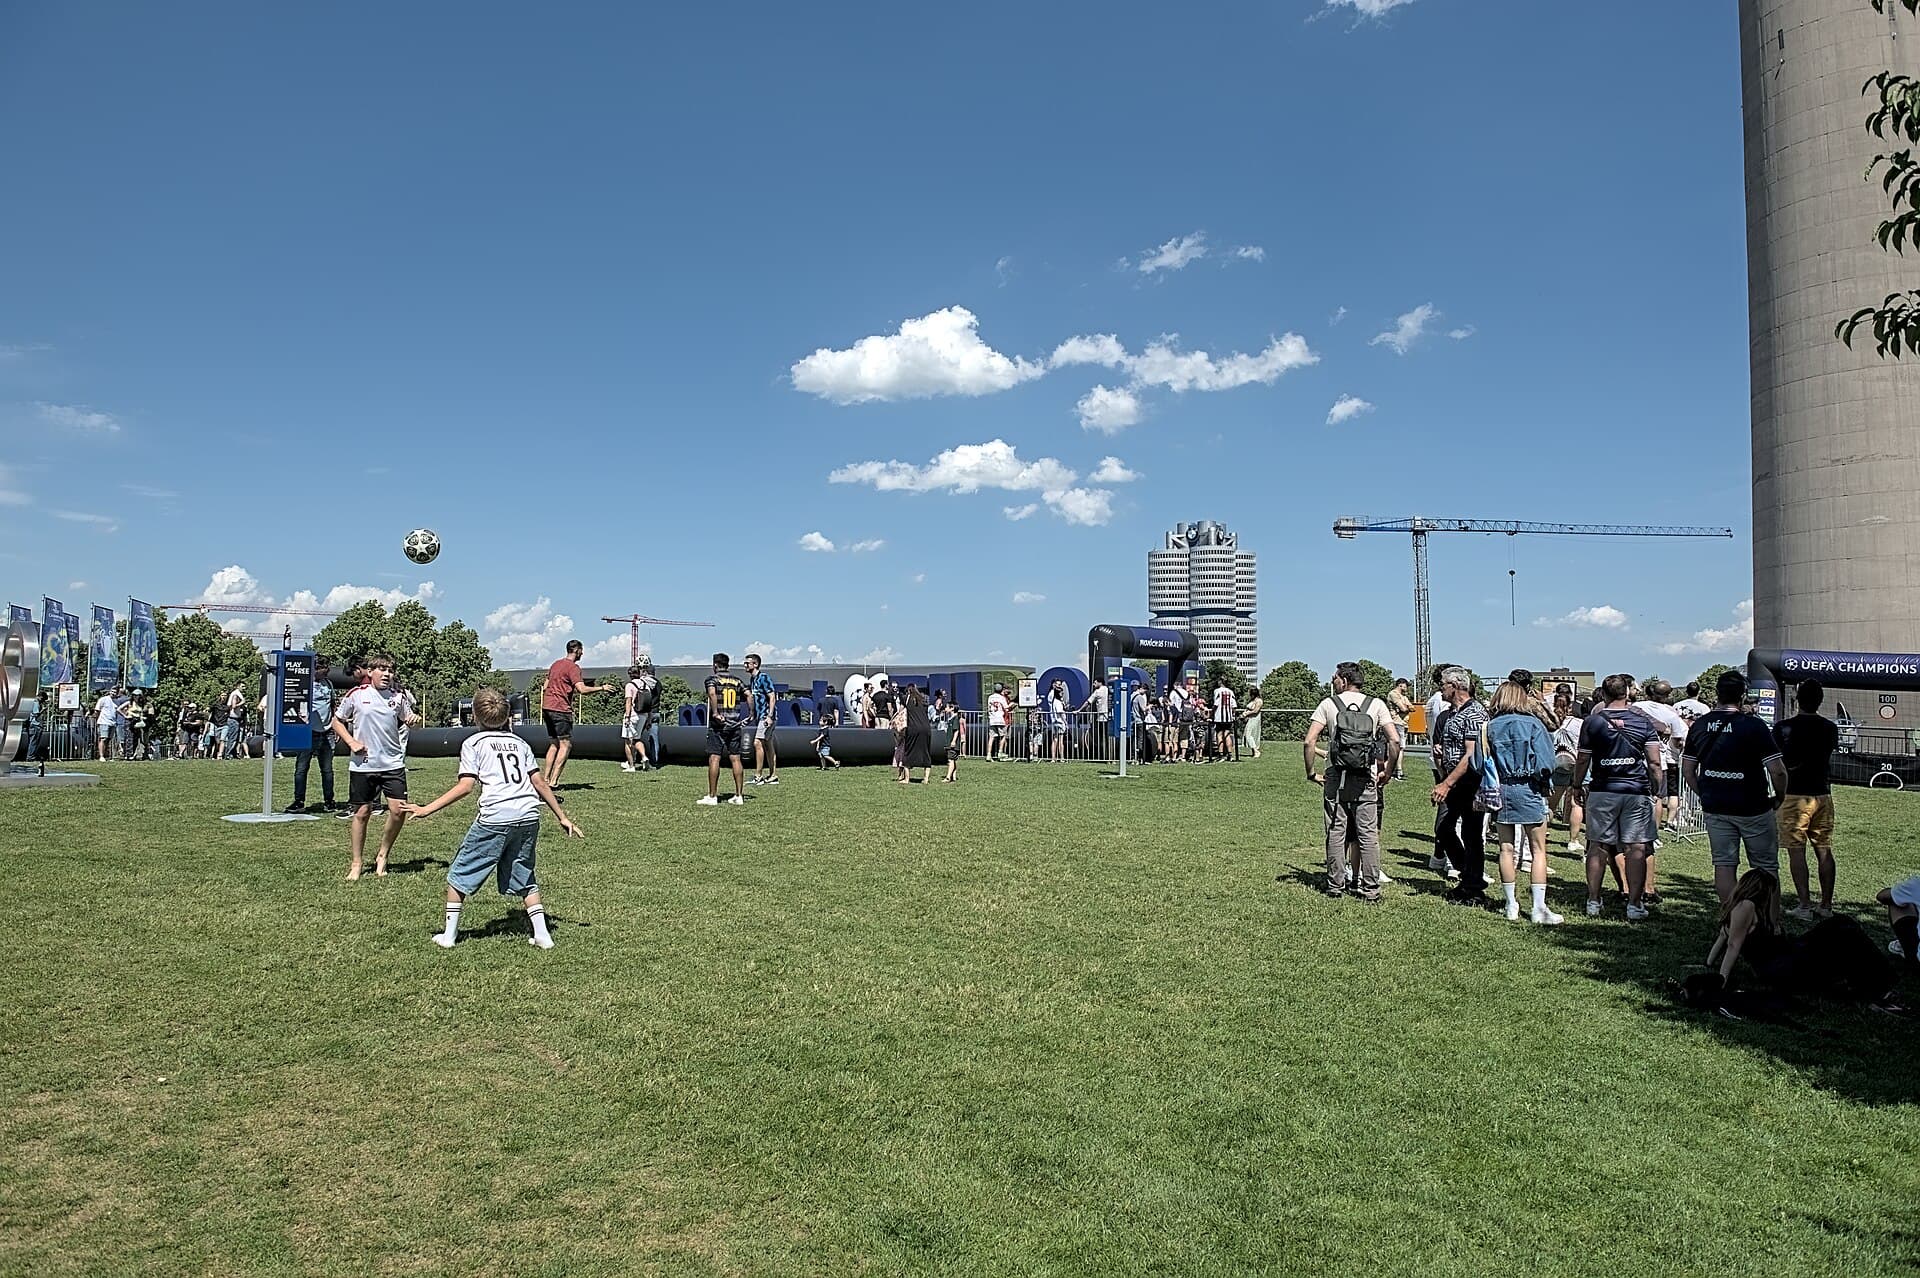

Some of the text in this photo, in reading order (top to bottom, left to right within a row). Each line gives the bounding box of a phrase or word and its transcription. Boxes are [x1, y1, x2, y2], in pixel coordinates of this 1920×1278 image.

[1164, 640, 1180, 649] FINAL
[294, 667, 310, 675] FREE
[1801, 660, 1918, 675] UEFA CHAMPIONS
[722, 688, 737, 709] 10
[1879, 695, 1896, 703] 100
[490, 741, 519, 753] MÜLLER
[496, 752, 523, 785] 13
[1880, 763, 1892, 771] 20
